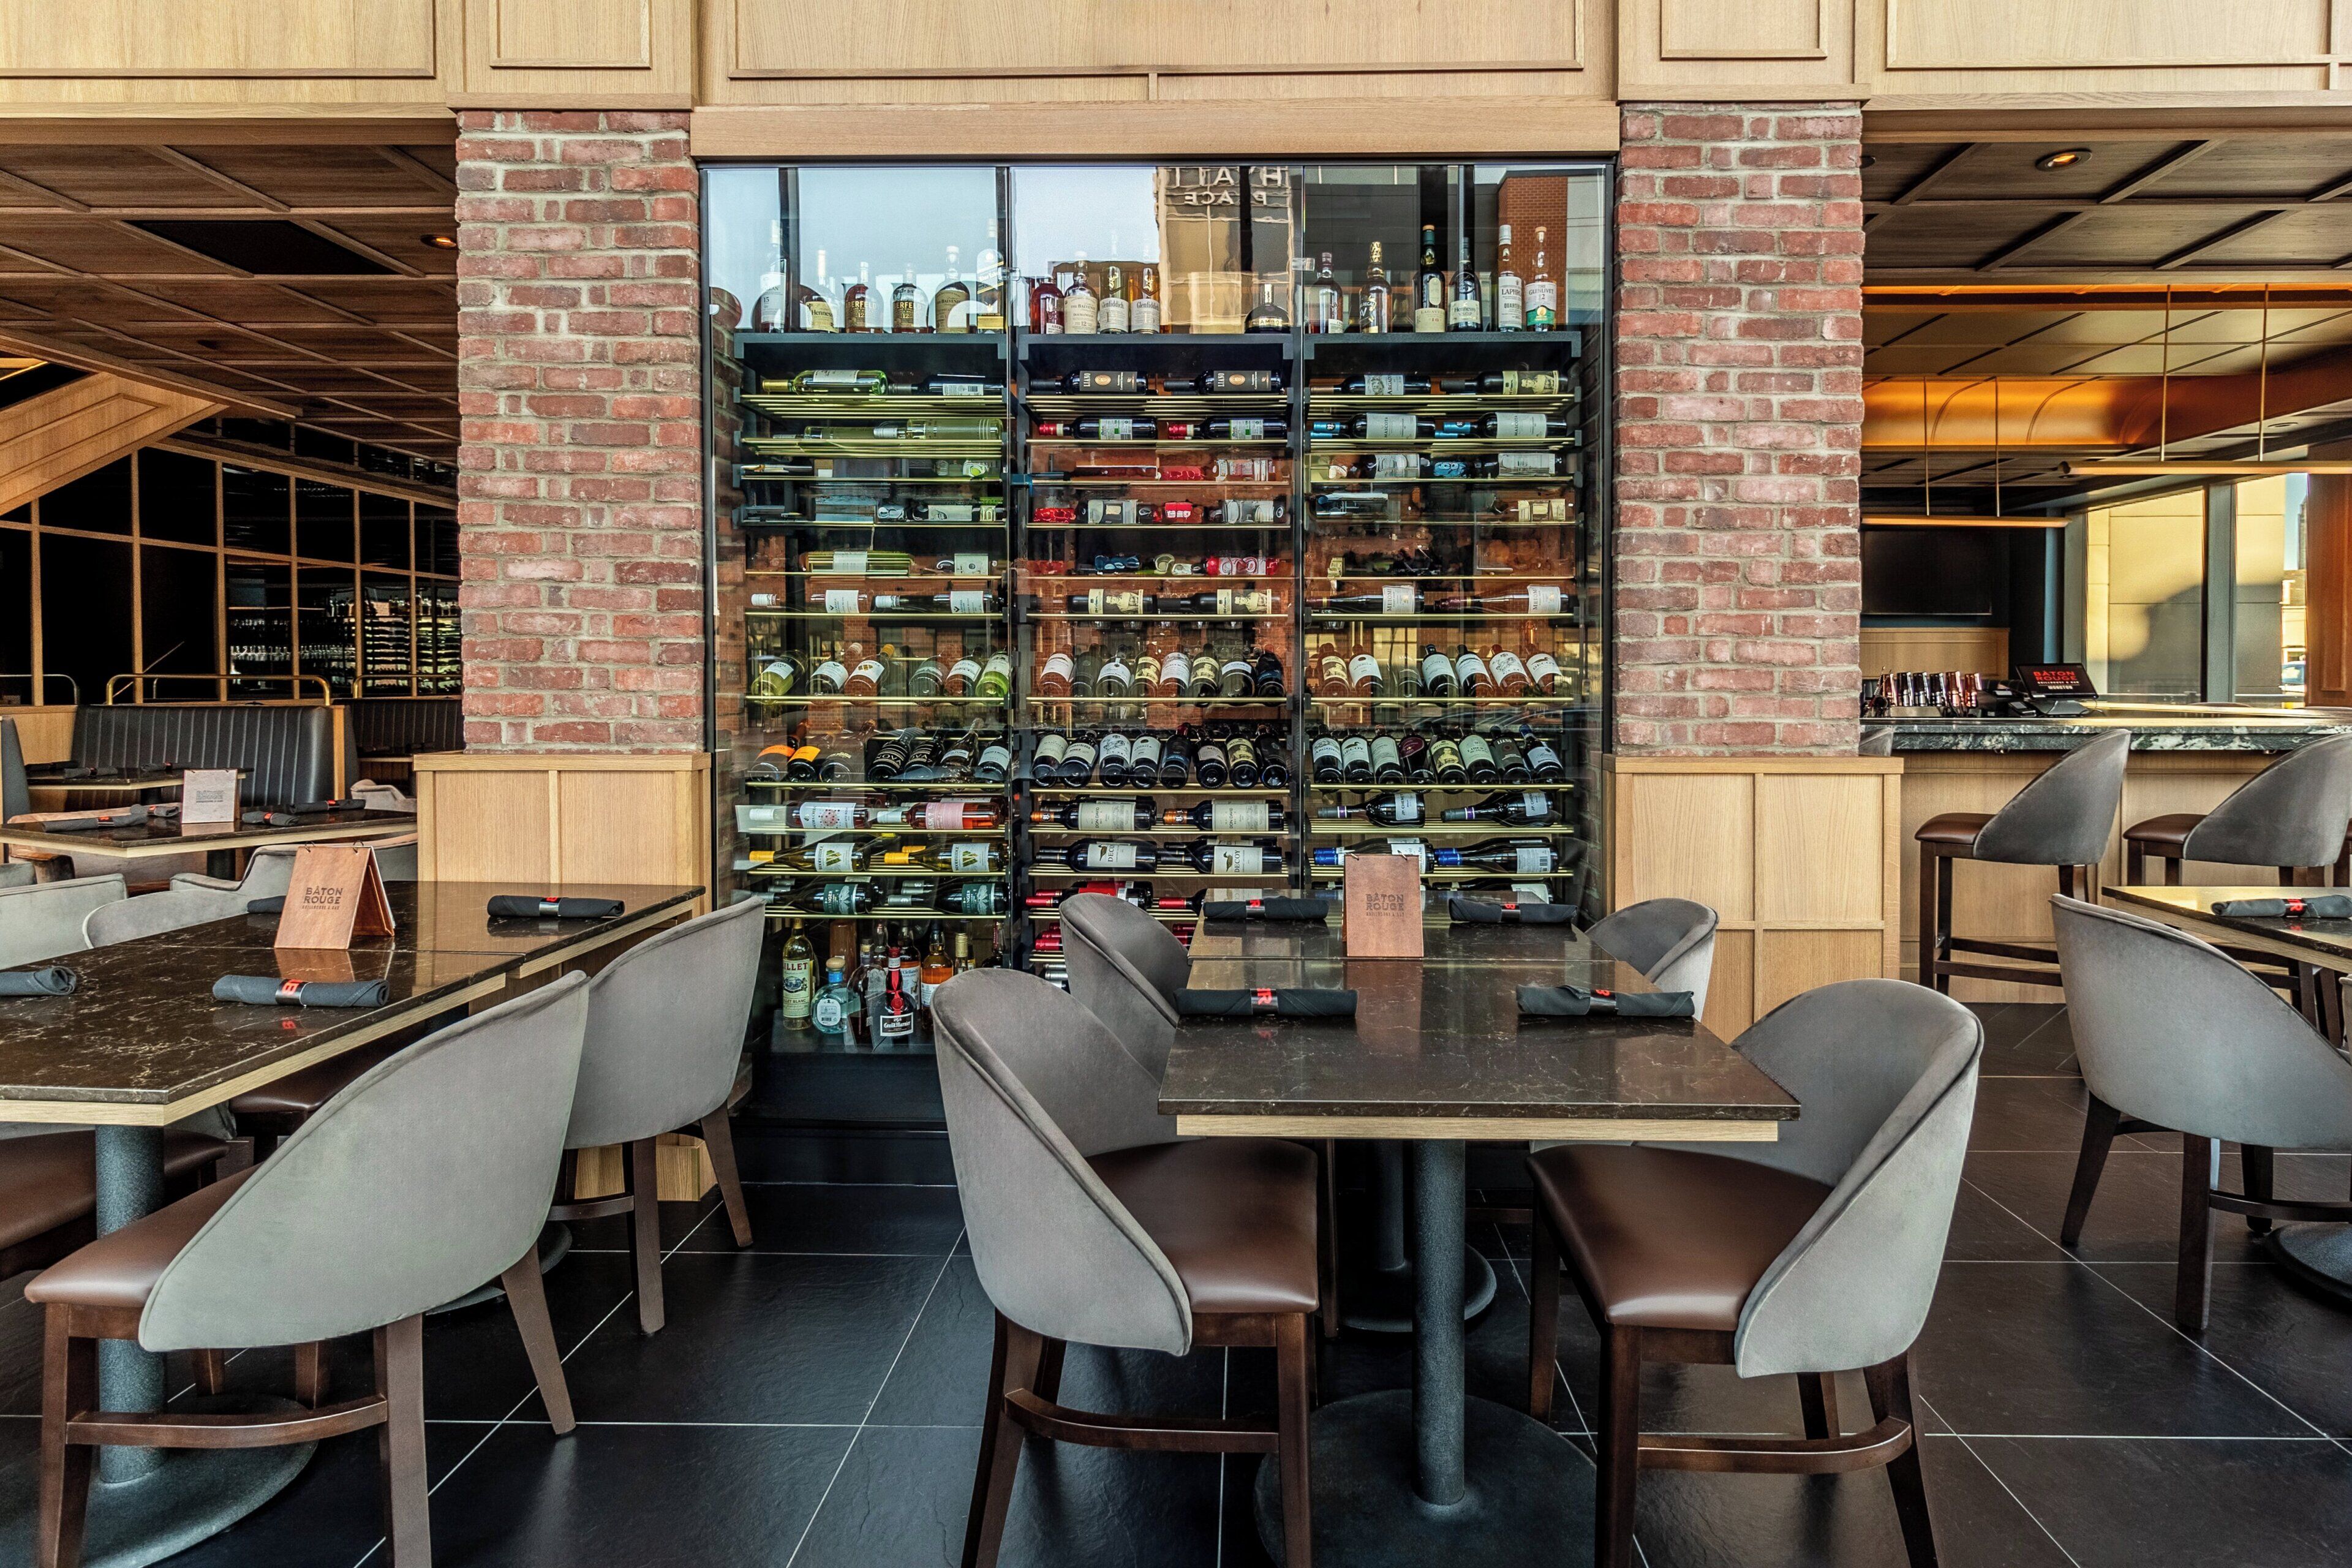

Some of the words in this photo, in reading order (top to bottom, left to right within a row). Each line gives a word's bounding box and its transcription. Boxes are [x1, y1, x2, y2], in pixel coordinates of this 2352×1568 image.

[876, 755, 902, 766] NOVA
[306, 886, 343, 895] BÂTON
[304, 895, 341, 904] ROUGE
[1365, 892, 1404, 902] BÂTON
[1366, 902, 1404, 911] ROUGE
